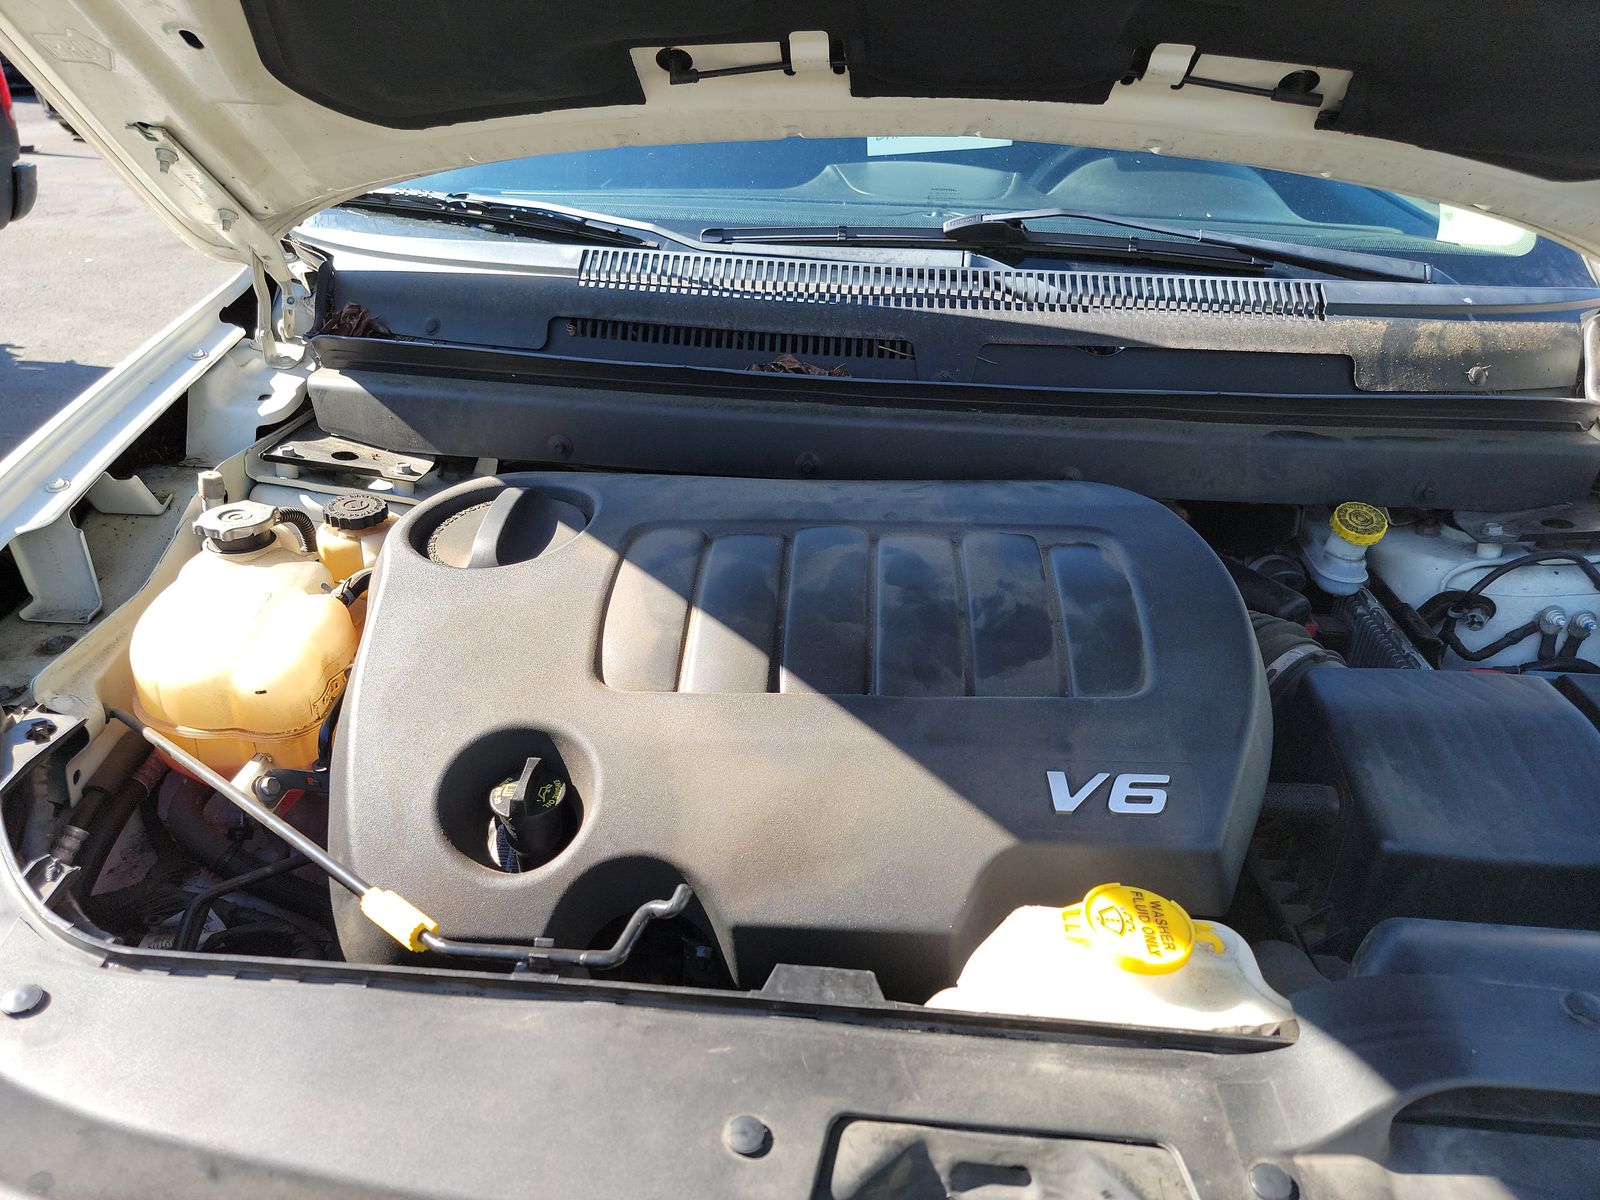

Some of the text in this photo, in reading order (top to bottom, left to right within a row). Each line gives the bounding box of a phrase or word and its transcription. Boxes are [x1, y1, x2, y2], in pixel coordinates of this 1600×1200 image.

[542, 799, 556, 808] OIL
[1046, 770, 1170, 814] V6
[1130, 890, 1163, 958] FLUID ONLY
[1149, 900, 1177, 951] WASHER
